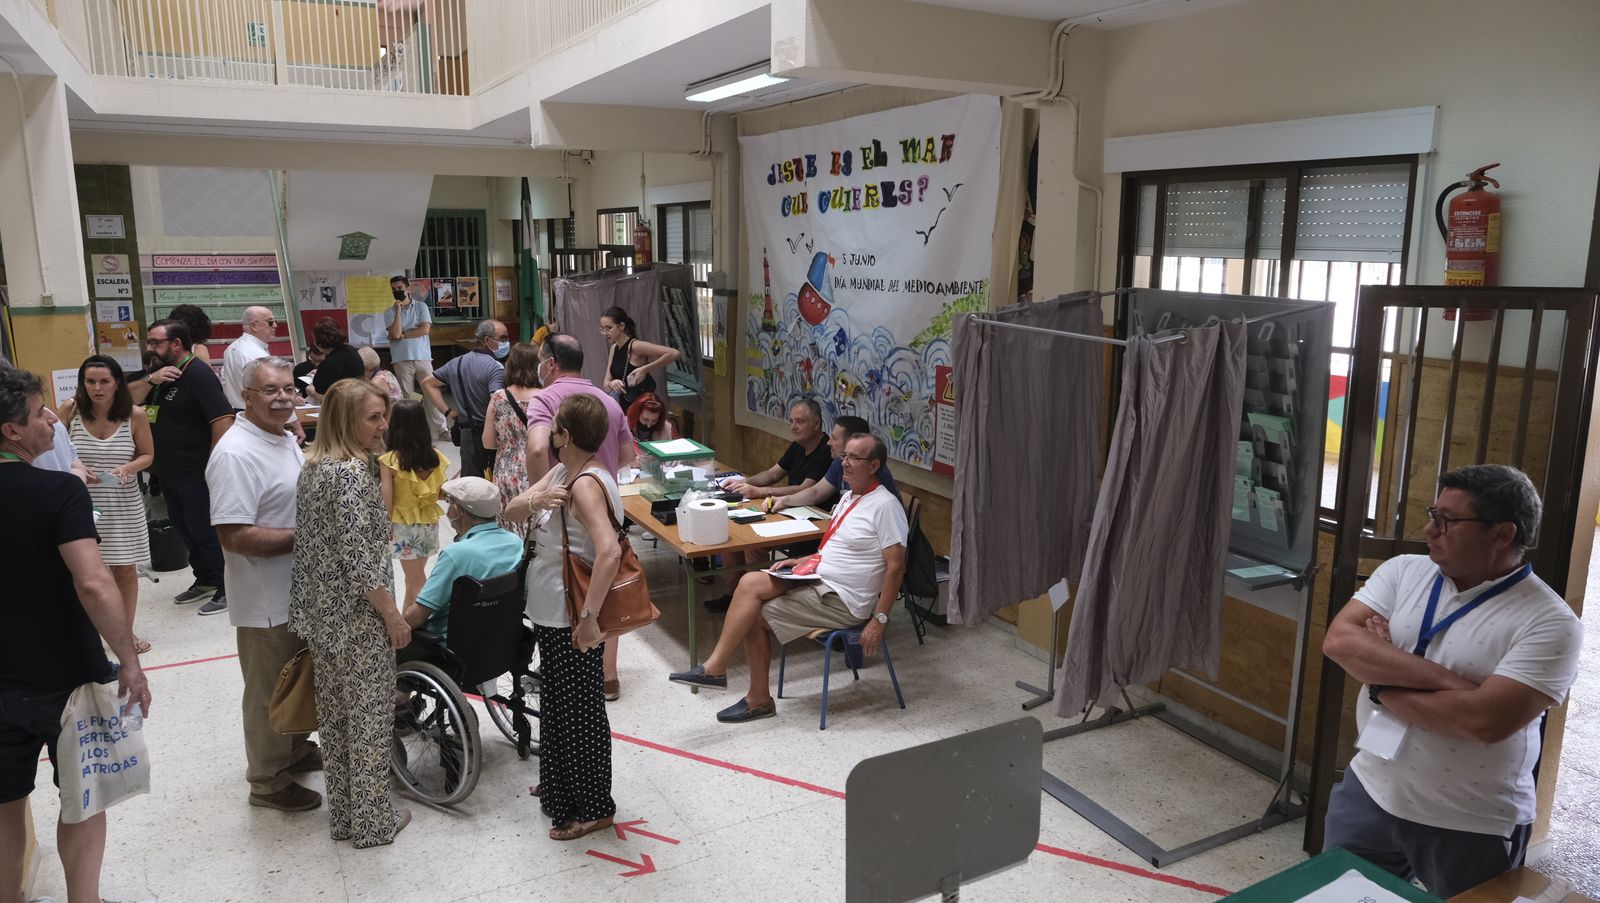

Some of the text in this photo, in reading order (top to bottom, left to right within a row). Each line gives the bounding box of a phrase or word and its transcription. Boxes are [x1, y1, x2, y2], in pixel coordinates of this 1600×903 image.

[829, 149, 853, 177] ES
[859, 138, 888, 170] EL
[899, 132, 956, 164] MAR
[849, 253, 876, 267] JUNIO
[850, 277, 885, 292] MUNDIAL
[888, 279, 900, 293] DEL
[904, 278, 984, 297] MEDIOAMBIENTE
[87, 747, 109, 759] LOS
